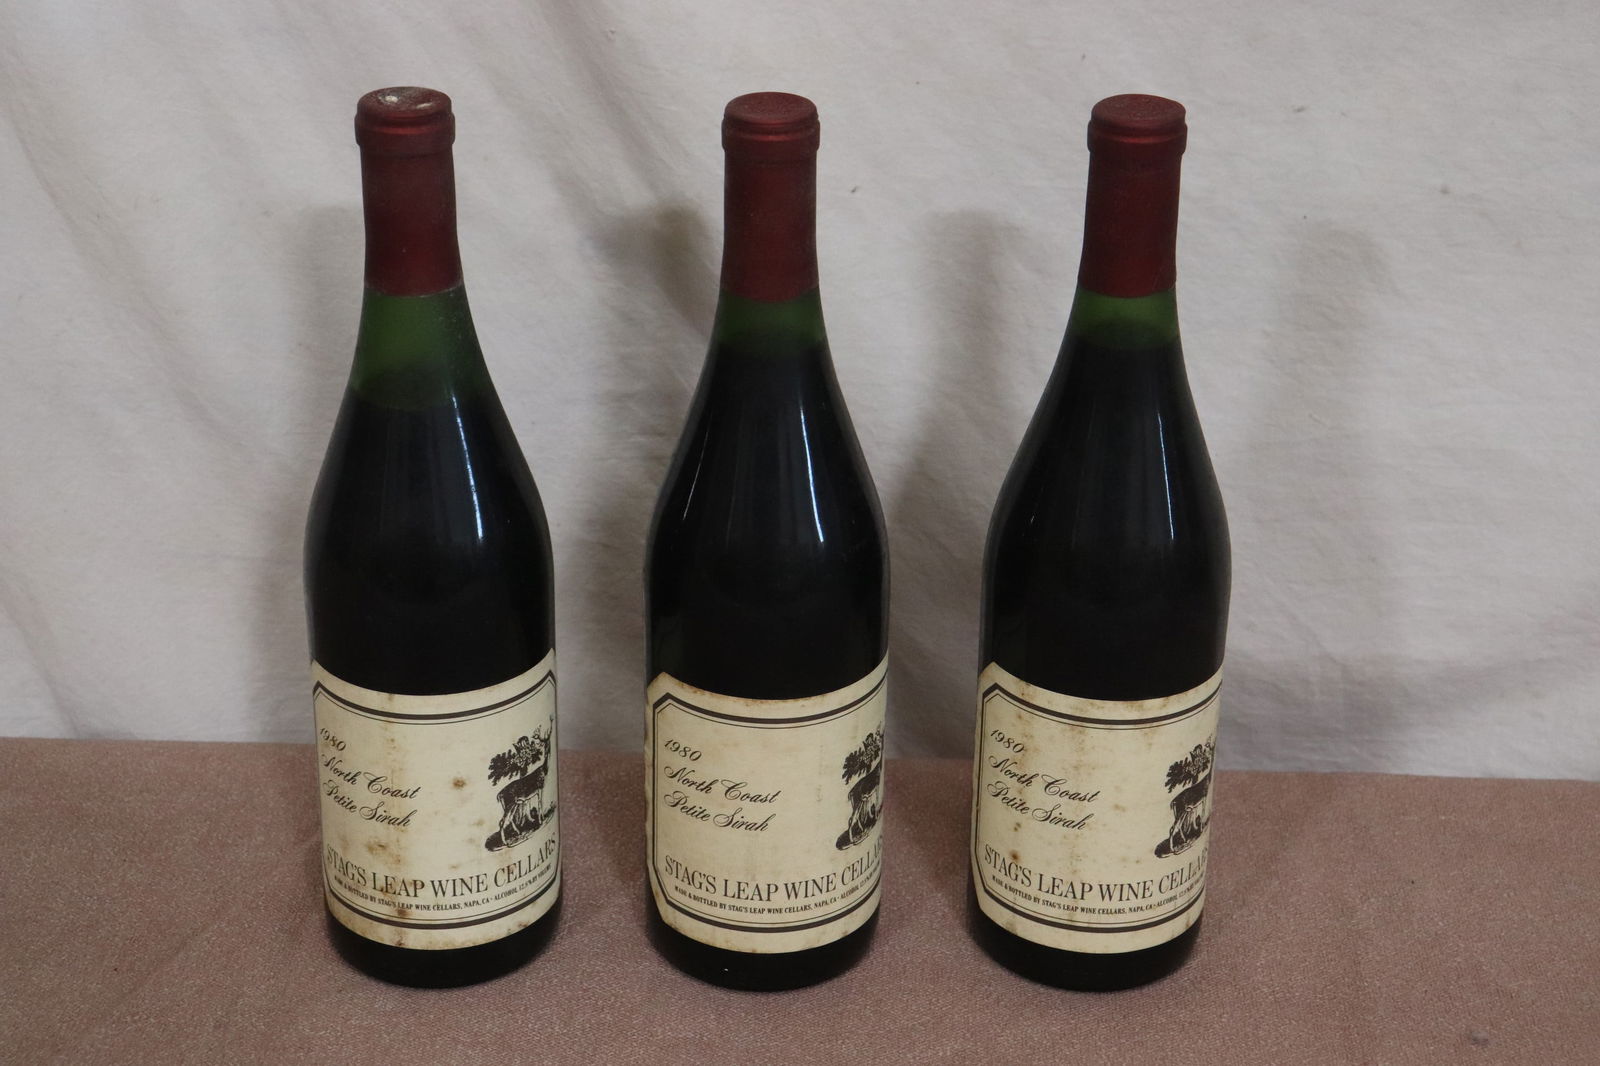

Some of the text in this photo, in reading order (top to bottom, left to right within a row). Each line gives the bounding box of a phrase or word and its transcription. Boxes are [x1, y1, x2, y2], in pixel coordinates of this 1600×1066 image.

[320, 728, 346, 751] 1980
[664, 739, 702, 761] 1980
[990, 729, 1025, 753] 1980
[322, 754, 421, 799] North Coast
[664, 766, 781, 803] North Coast
[988, 755, 1101, 803] North Coast
[323, 779, 417, 827] Petite Sirah
[664, 790, 776, 832] Petite Sirah
[987, 780, 1094, 830] Petite Sirah
[327, 843, 367, 887] STAG'S
[372, 872, 425, 898] LEAP
[430, 873, 488, 898] WINE
[665, 854, 717, 895] STAG'S
[723, 879, 779, 902] LEAP
[784, 872, 837, 900] WINE
[985, 844, 1032, 888] STAG'S
[1037, 873, 1093, 901] LEAP
[1098, 880, 1153, 902] WINE
[370, 895, 377, 903] BY
[397, 901, 414, 910] LEAP
[415, 904, 432, 912] WINE
[482, 897, 490, 905] CA
[693, 894, 718, 908] BOTTLED
[719, 902, 726, 910] BY
[728, 905, 748, 914] STAG'S
[749, 907, 766, 915] LEAP
[784, 904, 813, 913] CELLARS,
[830, 896, 837, 904] CA
[1008, 885, 1032, 902] BOTTLED
[1033, 896, 1041, 905] BY
[1042, 899, 1062, 910] STAG'S
[1063, 904, 1079, 913] LEAP
[1080, 907, 1096, 915] WINE
[1145, 903, 1153, 911] CA
